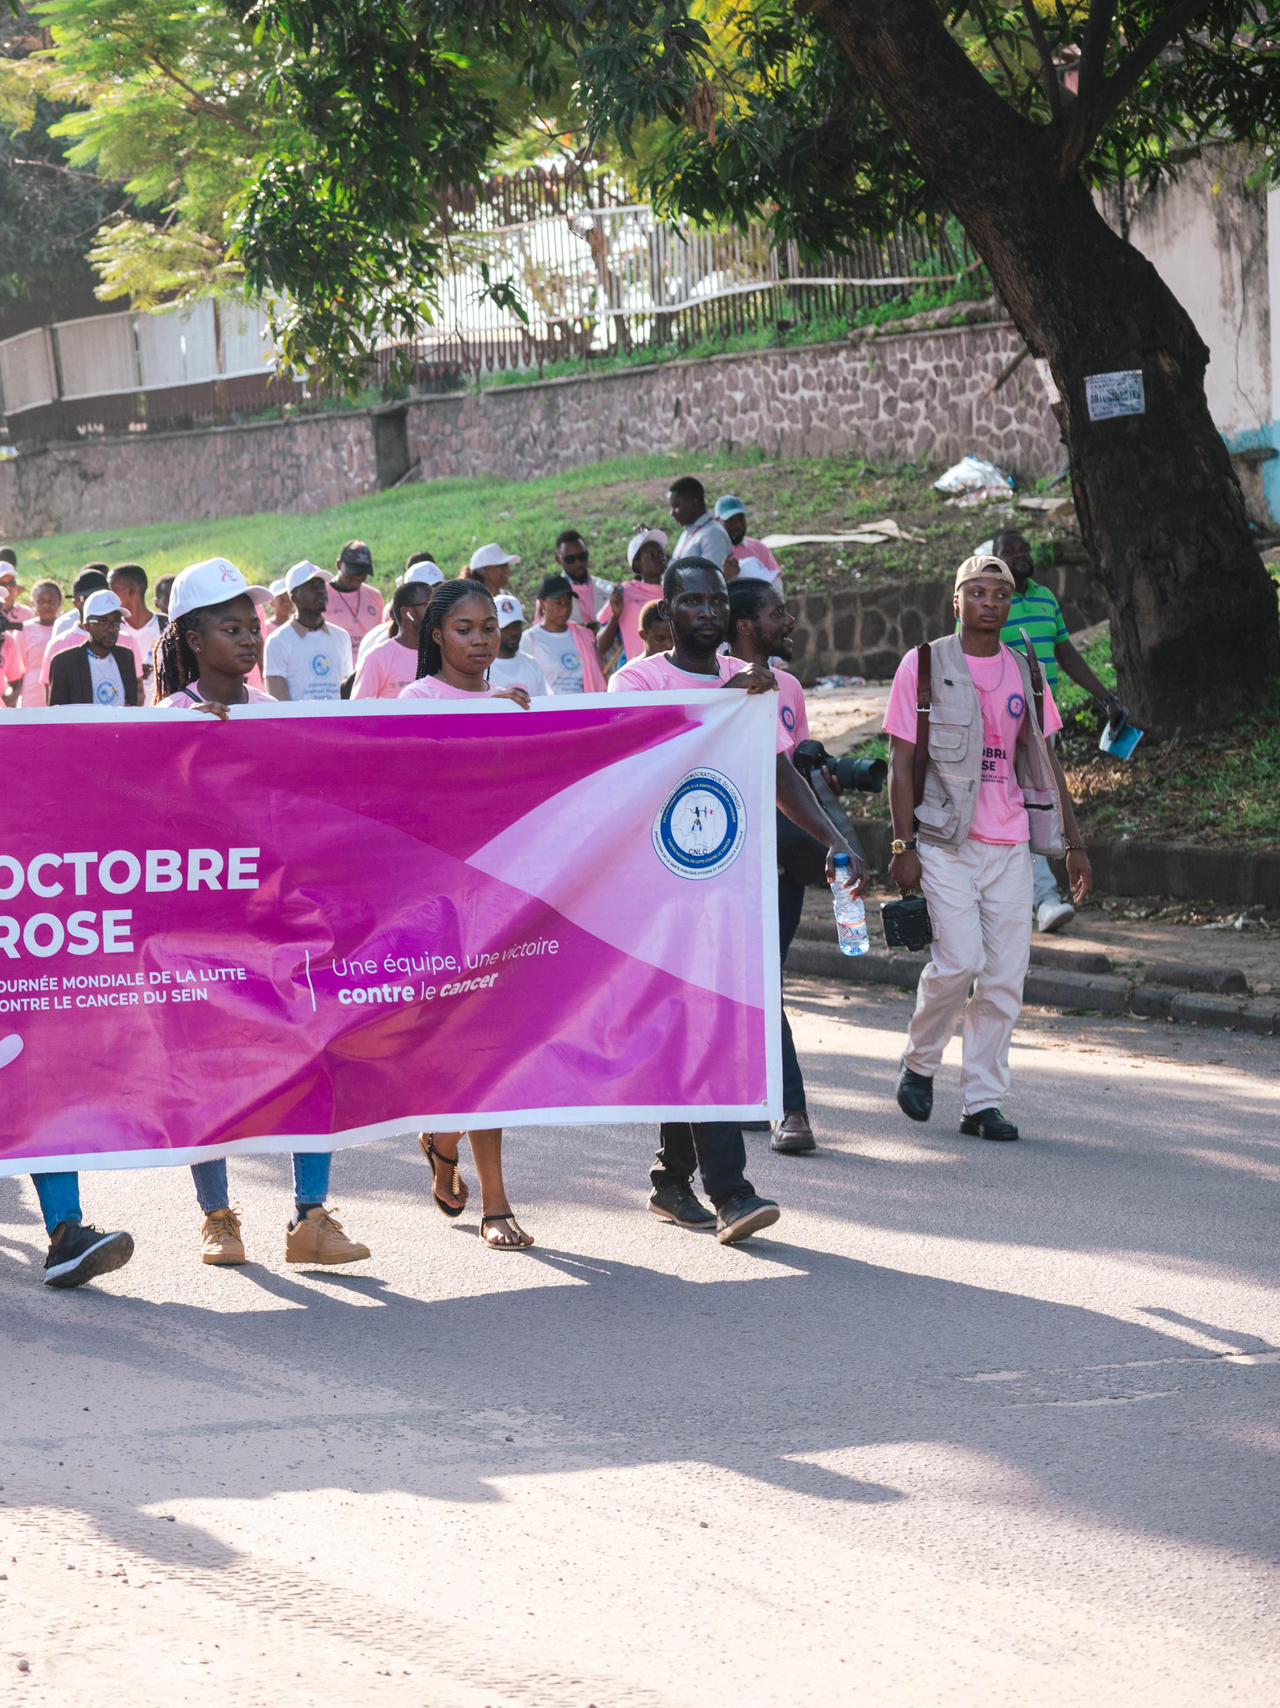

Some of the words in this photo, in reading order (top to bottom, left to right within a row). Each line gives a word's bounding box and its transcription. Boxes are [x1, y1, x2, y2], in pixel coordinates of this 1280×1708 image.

[332, 958, 377, 976] Une
[384, 951, 461, 975] équipe,
[501, 936, 559, 963] victoire
[63, 972, 144, 990] MONDIALE
[148, 970, 170, 985] DE
[176, 969, 196, 983] LA
[200, 968, 247, 982] LUTTE
[338, 982, 415, 1005] contre
[421, 980, 437, 1001] le
[439, 972, 498, 998] cancer
[54, 996, 72, 1010] LE
[77, 993, 139, 1008] CANCER
[144, 991, 167, 1004] DU
[172, 988, 208, 1002] SEIN
